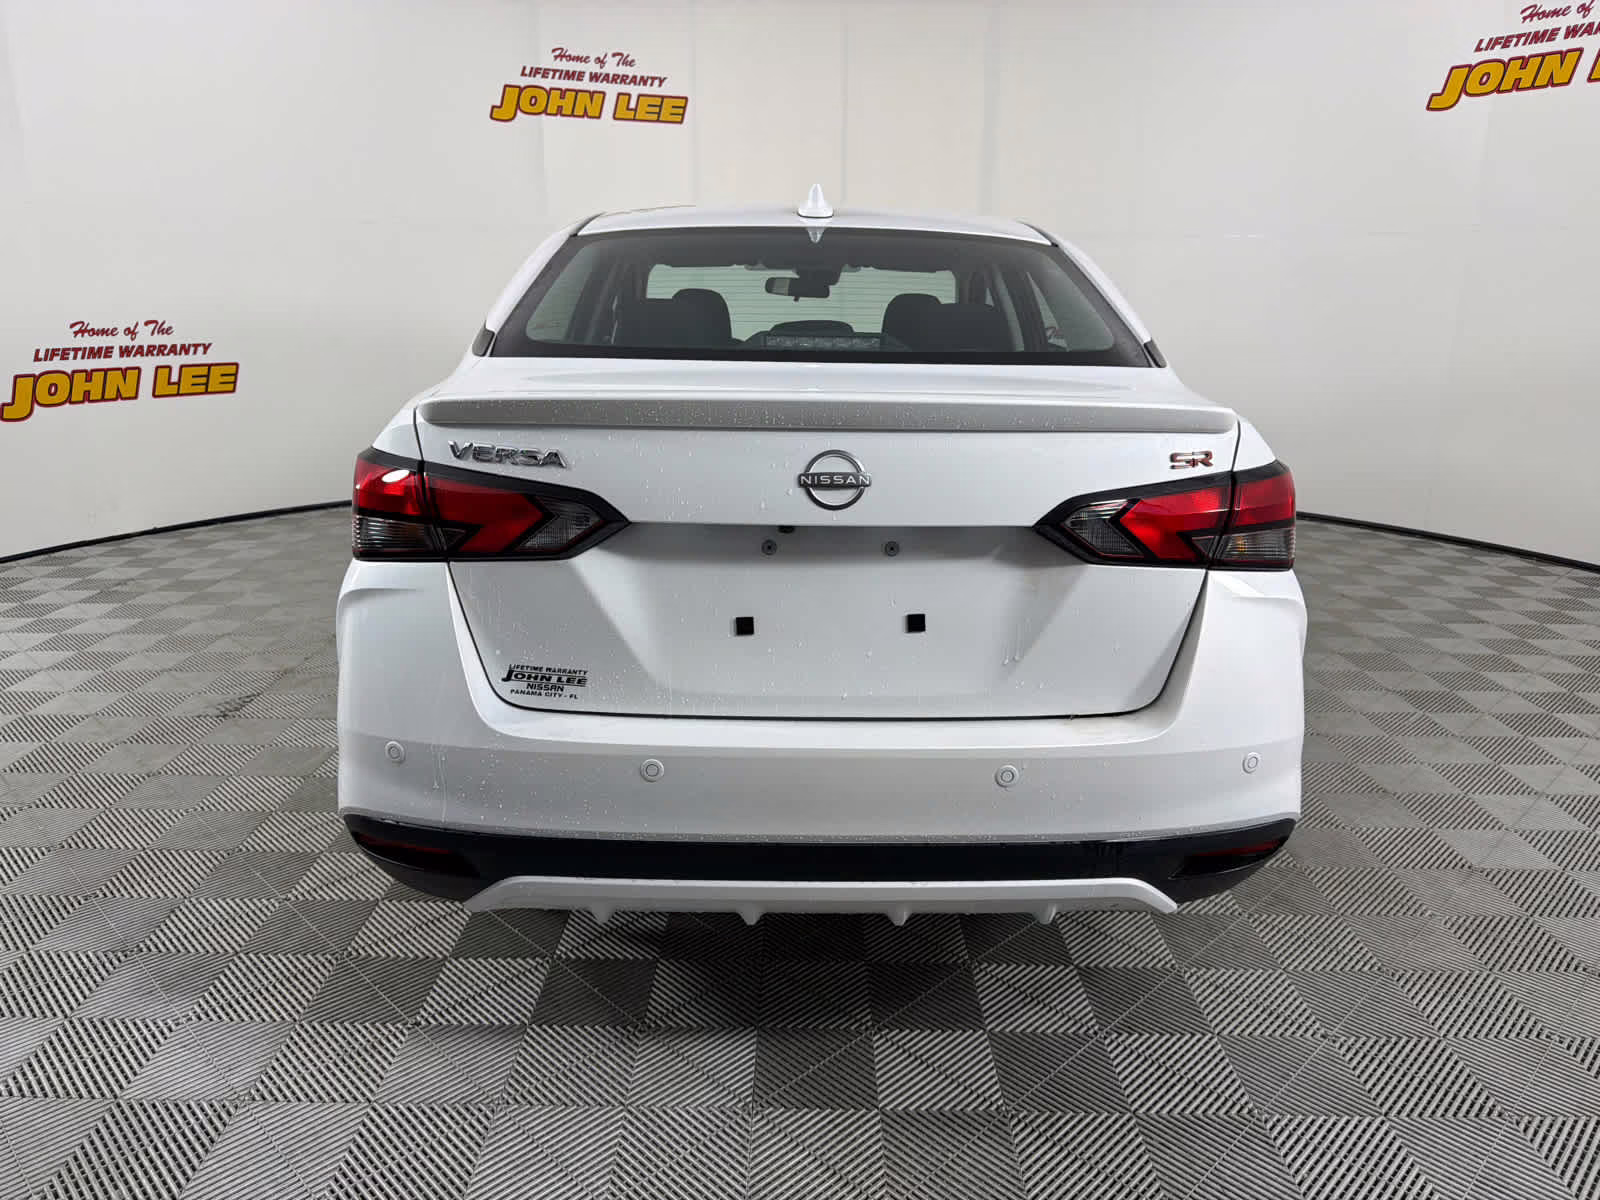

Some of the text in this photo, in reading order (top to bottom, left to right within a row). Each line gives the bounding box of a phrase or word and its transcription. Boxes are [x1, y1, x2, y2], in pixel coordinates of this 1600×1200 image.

[1519, 0, 1595, 24] Home of
[1473, 27, 1561, 53] LIFETIME
[551, 47, 637, 69] Home of The
[520, 66, 668, 88] LIFETIME WARRANTY
[1426, 47, 1584, 111] JOHN
[490, 84, 688, 125] JOHN LEE
[69, 319, 174, 341] Home of The
[33, 342, 213, 362] LIFETIME WARRANTY
[0, 362, 239, 422] JOHN LEE
[447, 440, 568, 469] VERSA
[1169, 450, 1213, 470] SR
[800, 474, 870, 486] NISSAN
[501, 669, 588, 686] JOHN LEE
[545, 667, 588, 676] WARRANTY
[510, 689, 542, 697] PANAMA
[526, 683, 564, 692] NISSAN
